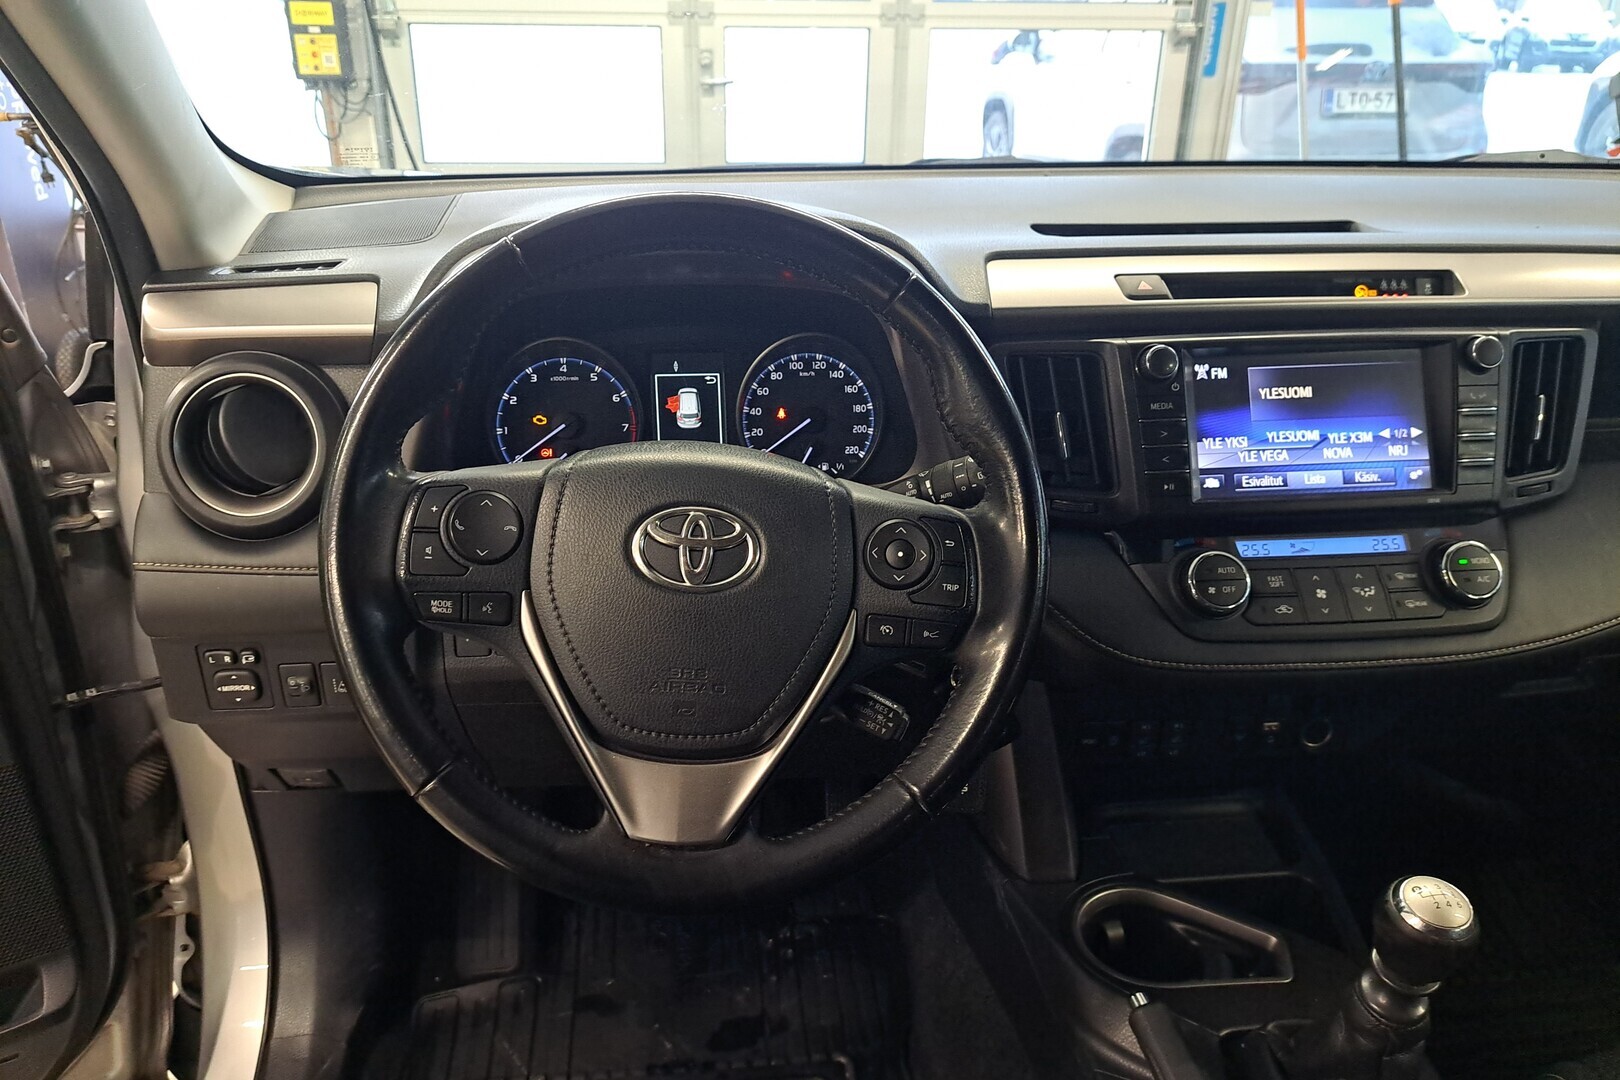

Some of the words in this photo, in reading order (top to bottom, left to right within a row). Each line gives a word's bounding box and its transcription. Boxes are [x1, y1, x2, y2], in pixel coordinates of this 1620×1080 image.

[560, 364, 568, 372] 4
[788, 362, 804, 370] 100
[812, 361, 826, 370] 120
[530, 374, 538, 382] 3
[590, 372, 598, 382] 5
[770, 372, 783, 380] 80
[829, 370, 844, 379] 140
[1211, 367, 1228, 380] FM
[756, 387, 770, 396] 60
[844, 384, 858, 394] 160
[1258, 386, 1313, 400] YLESUOMI
[509, 396, 518, 405] 2
[612, 394, 620, 402] 6
[852, 404, 866, 413] 180
[1150, 402, 1174, 410] MEDIA
[750, 407, 762, 416] 40
[504, 426, 508, 435] 1
[622, 423, 630, 432] 7
[751, 428, 764, 436] 20
[852, 425, 868, 434] 200
[1266, 430, 1320, 443] YLESUOMI
[1328, 432, 1348, 444] YLE
[1349, 431, 1374, 443] X3M
[1394, 428, 1408, 438] 1/2
[1202, 437, 1223, 450] YLE
[1224, 436, 1248, 448] YKSI
[844, 446, 860, 454] 220
[1322, 446, 1354, 459] NOVA
[1388, 444, 1408, 456] NRJ
[1238, 450, 1258, 462] YLE
[1259, 449, 1290, 462] VEGA
[1242, 474, 1284, 488] Esivalitut
[1304, 472, 1326, 484] Lista
[940, 492, 953, 500] AUTO
[1372, 538, 1400, 551] 25.5
[1241, 543, 1271, 556] 25.5
[1217, 566, 1236, 574] AUTO
[942, 583, 960, 592] TRIP
[1222, 586, 1236, 594] OFF
[430, 600, 454, 608] MODE
[208, 656, 216, 664] L
[223, 655, 232, 663] R
[221, 684, 251, 692] MIRROR
[874, 702, 889, 714] RES
[866, 720, 881, 732] SET
[1432, 901, 1442, 910] 2
[1446, 900, 1453, 908] 4
